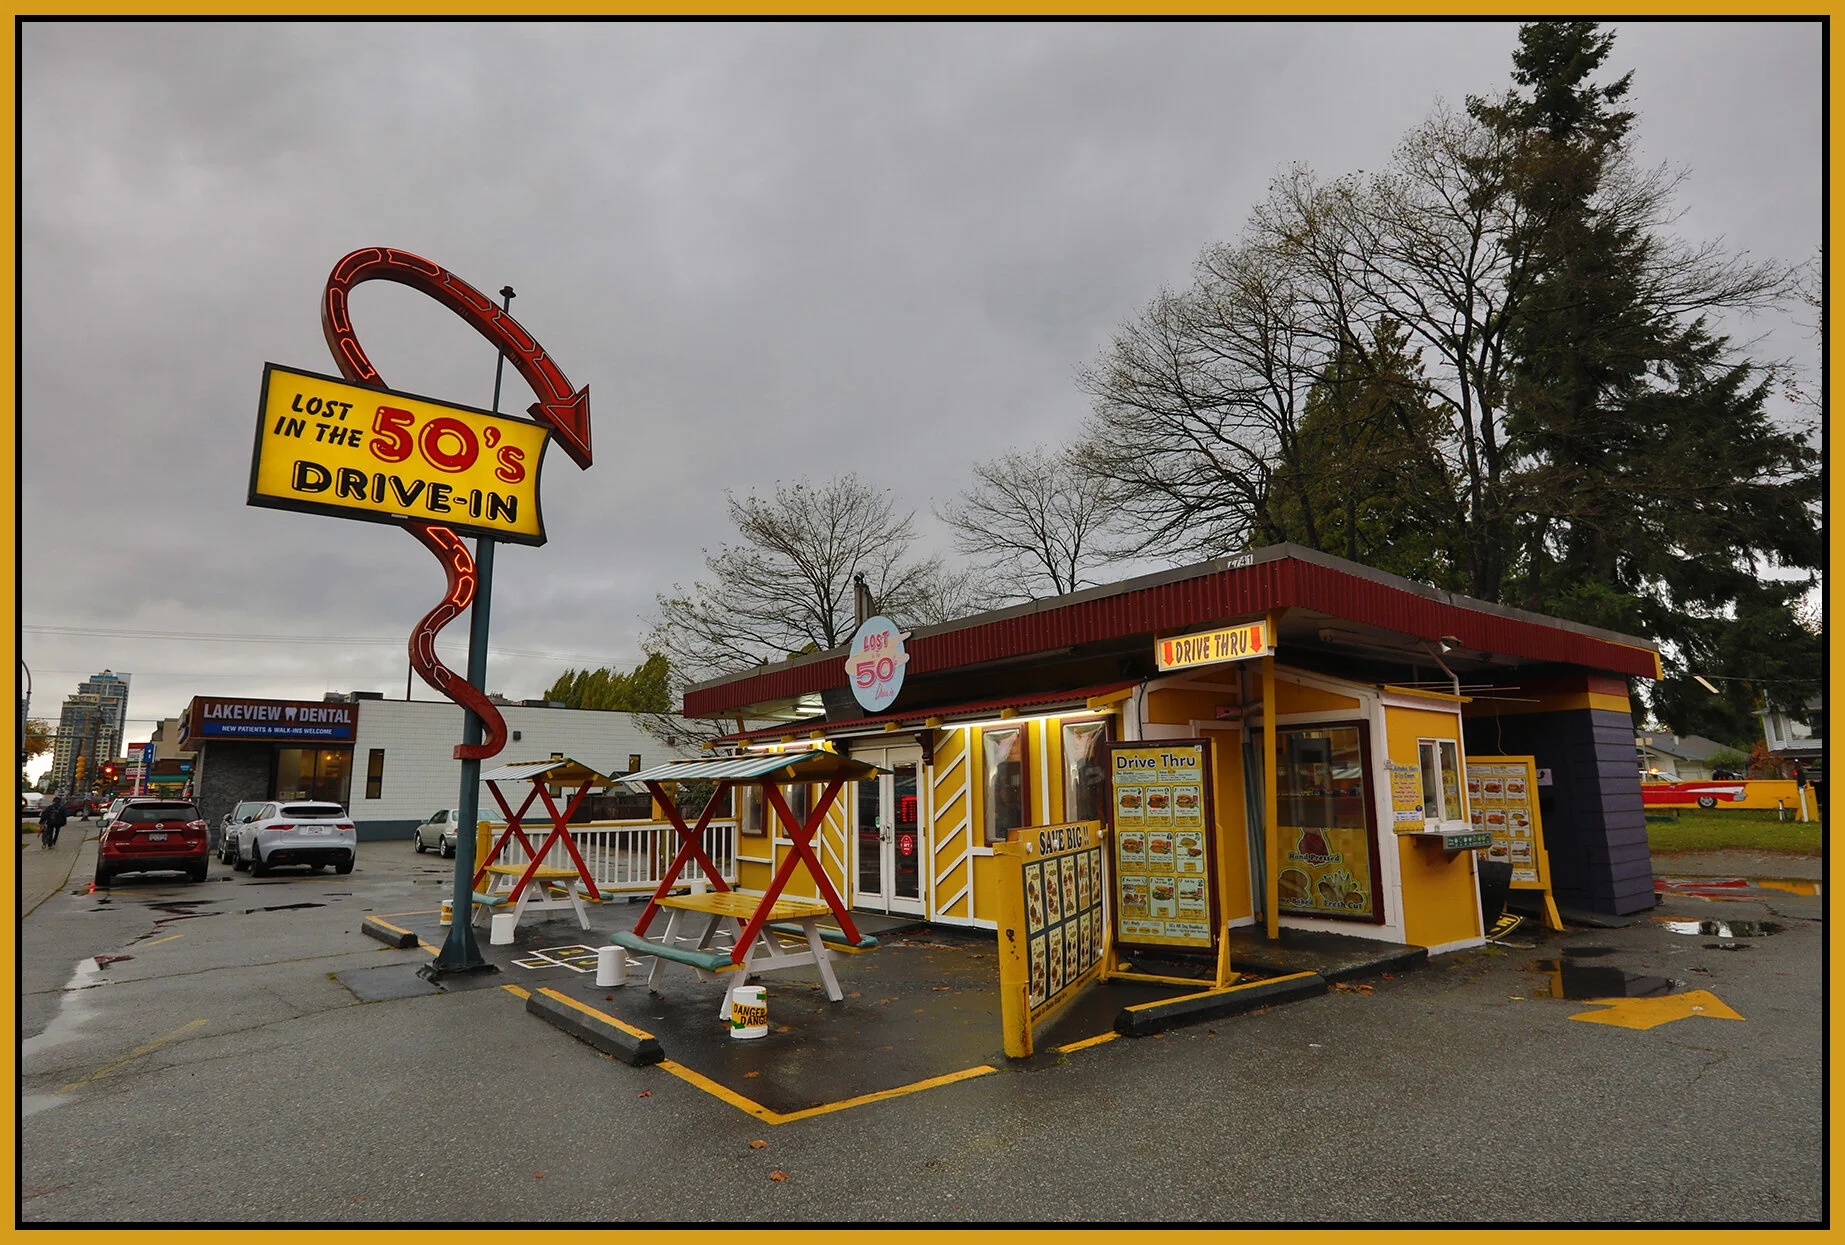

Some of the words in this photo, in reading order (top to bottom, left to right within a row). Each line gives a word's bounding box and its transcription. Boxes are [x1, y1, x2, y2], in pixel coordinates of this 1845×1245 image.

[291, 393, 353, 421] LOST
[273, 416, 306, 439] IN
[315, 423, 364, 448] THE
[291, 460, 519, 524] DRIVE-IN
[863, 631, 889, 652] LOST
[1175, 636, 1211, 664] DRIVE
[1214, 629, 1248, 658] THRU
[203, 703, 282, 721] LAKEVIEW
[299, 707, 352, 723] DENTAL
[237, 725, 267, 733] PATIENTS
[1117, 755, 1156, 769] Drive
[1160, 753, 1196, 767] Thru
[1040, 829, 1065, 856] SAVE
[1066, 826, 1083, 850] BIG
[1289, 853, 1309, 861] Hand
[1324, 900, 1346, 908] Fresh
[1348, 901, 1362, 909] Cut
